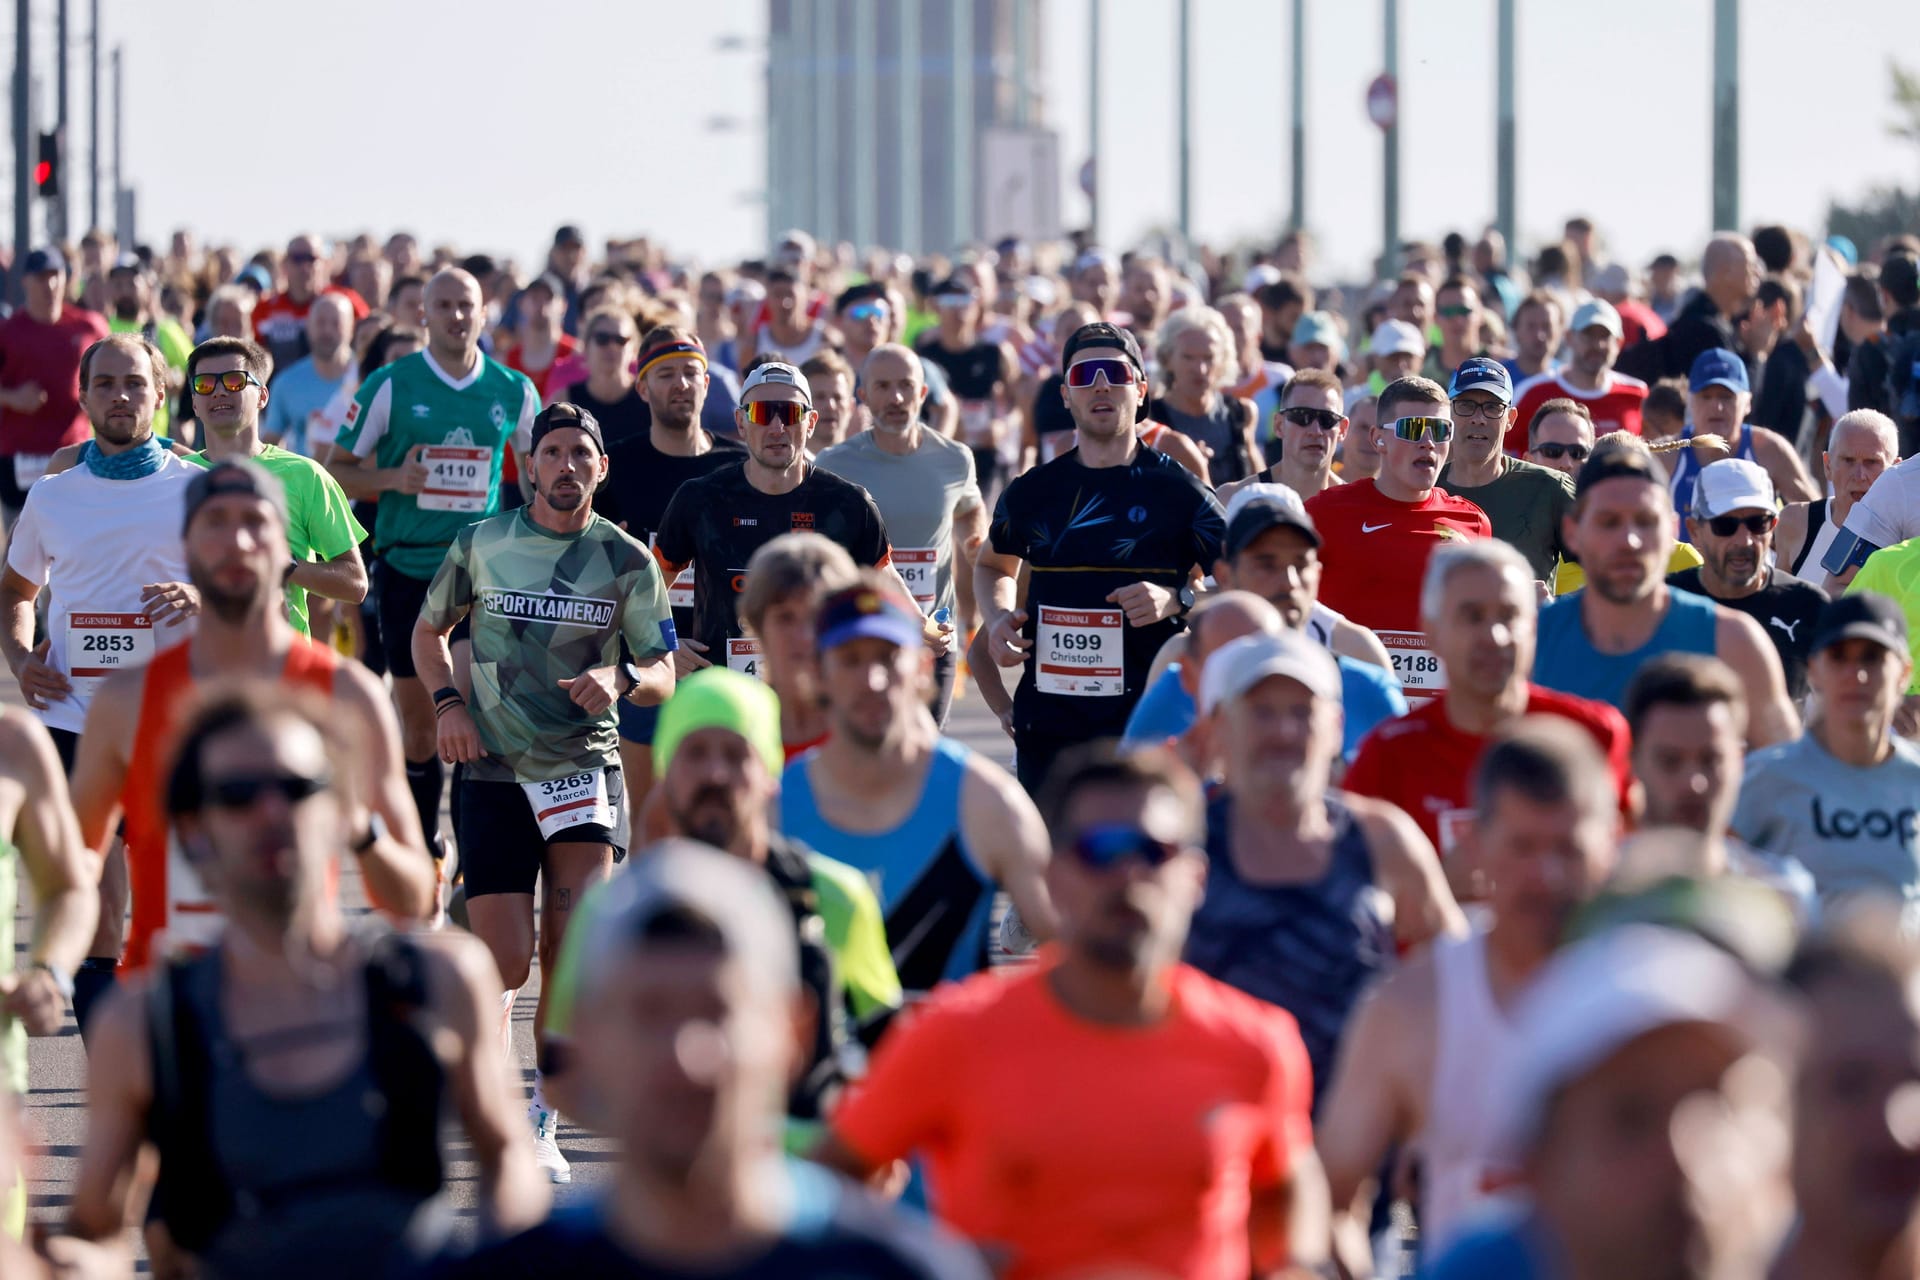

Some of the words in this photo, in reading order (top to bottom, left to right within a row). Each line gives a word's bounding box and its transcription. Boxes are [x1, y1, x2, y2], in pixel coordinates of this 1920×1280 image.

[434, 464, 476, 477] 4110
[486, 592, 612, 623] SPORTKAMERAD
[1054, 613, 1088, 624] GENERALI
[83, 635, 134, 651] 2853
[1052, 632, 1102, 650] 1699
[99, 655, 119, 664] Jan
[1050, 651, 1103, 664] Christoph
[1391, 655, 1438, 672] 2188
[1404, 674, 1424, 684] Jan
[541, 773, 594, 795] 3269
[552, 788, 590, 803] Marcel
